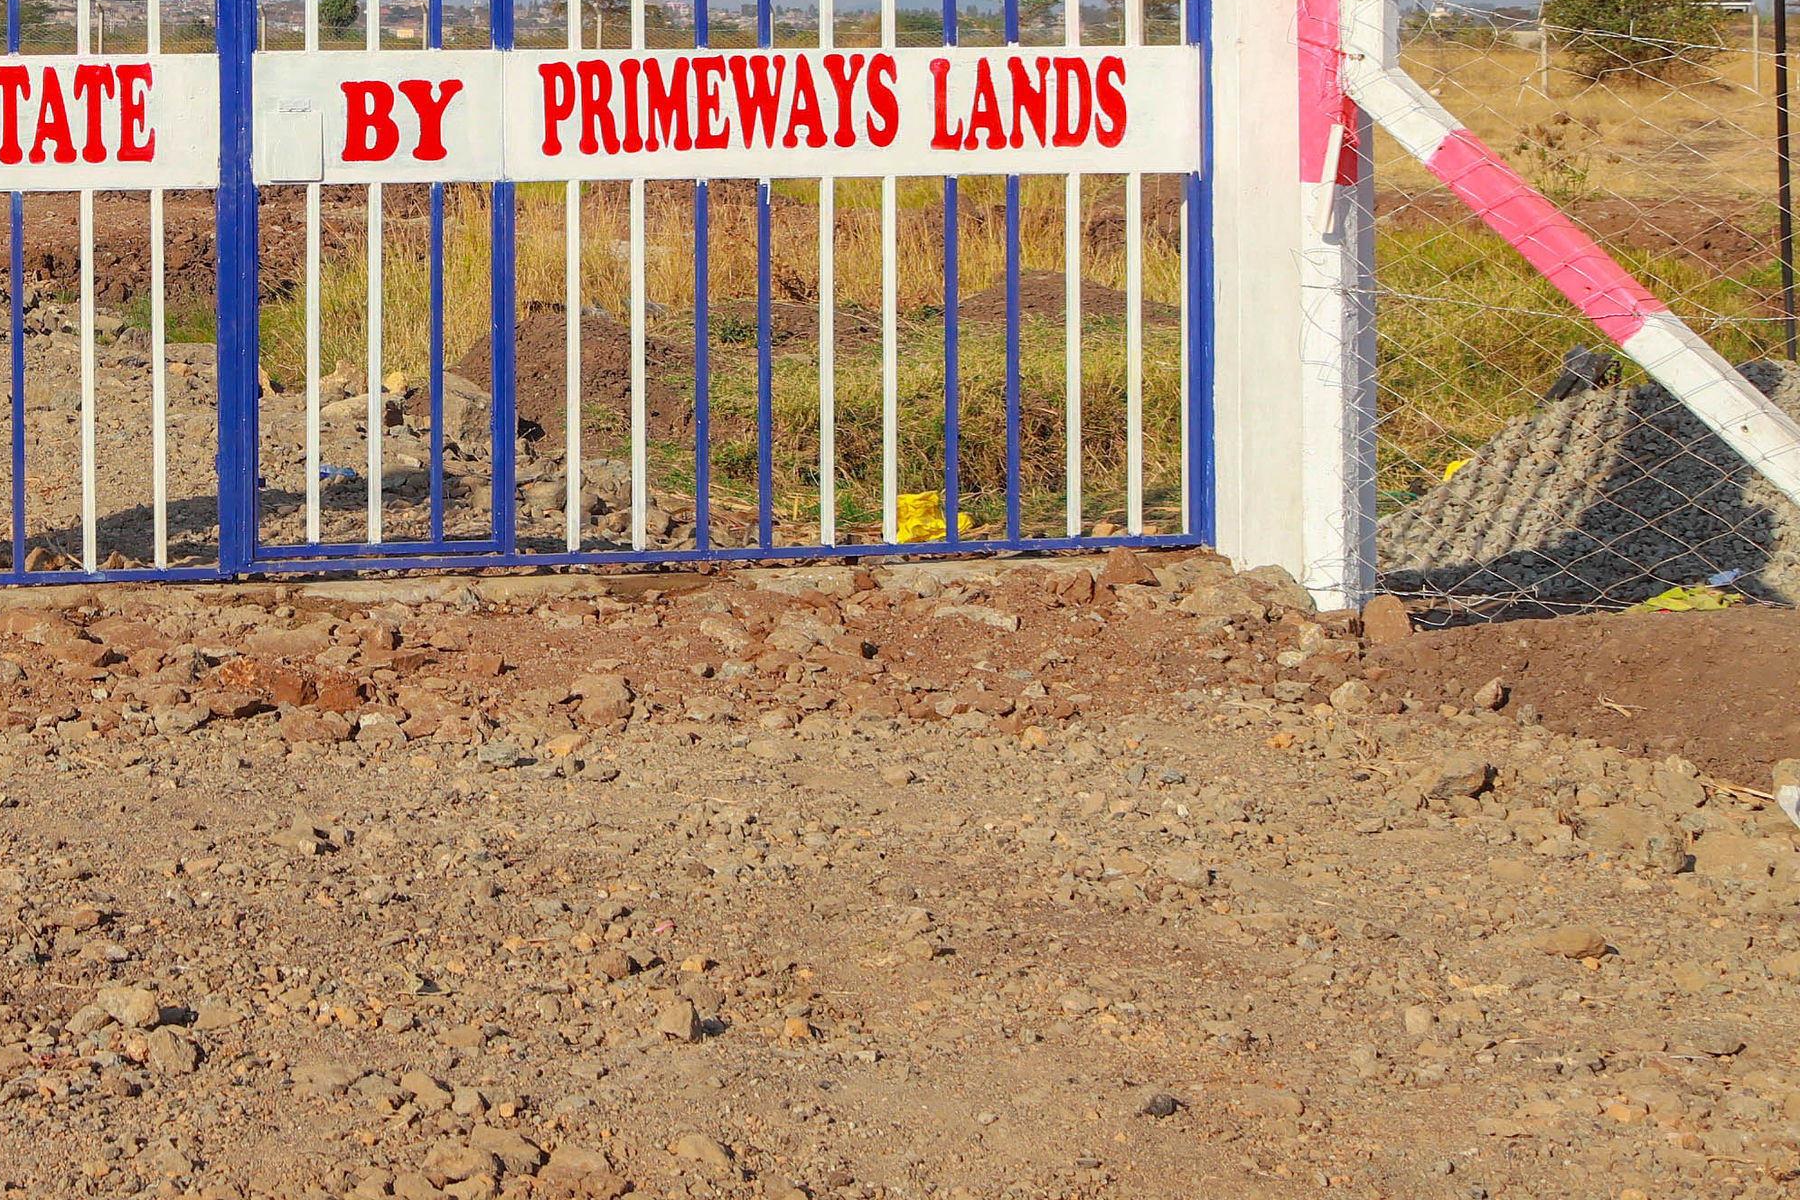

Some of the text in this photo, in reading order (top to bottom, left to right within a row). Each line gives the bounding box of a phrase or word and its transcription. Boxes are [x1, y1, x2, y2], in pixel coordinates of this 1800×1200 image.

[340, 79, 464, 162] BY
[538, 53, 898, 156] PRIMEWAYS
[928, 56, 1127, 150] LANDS
